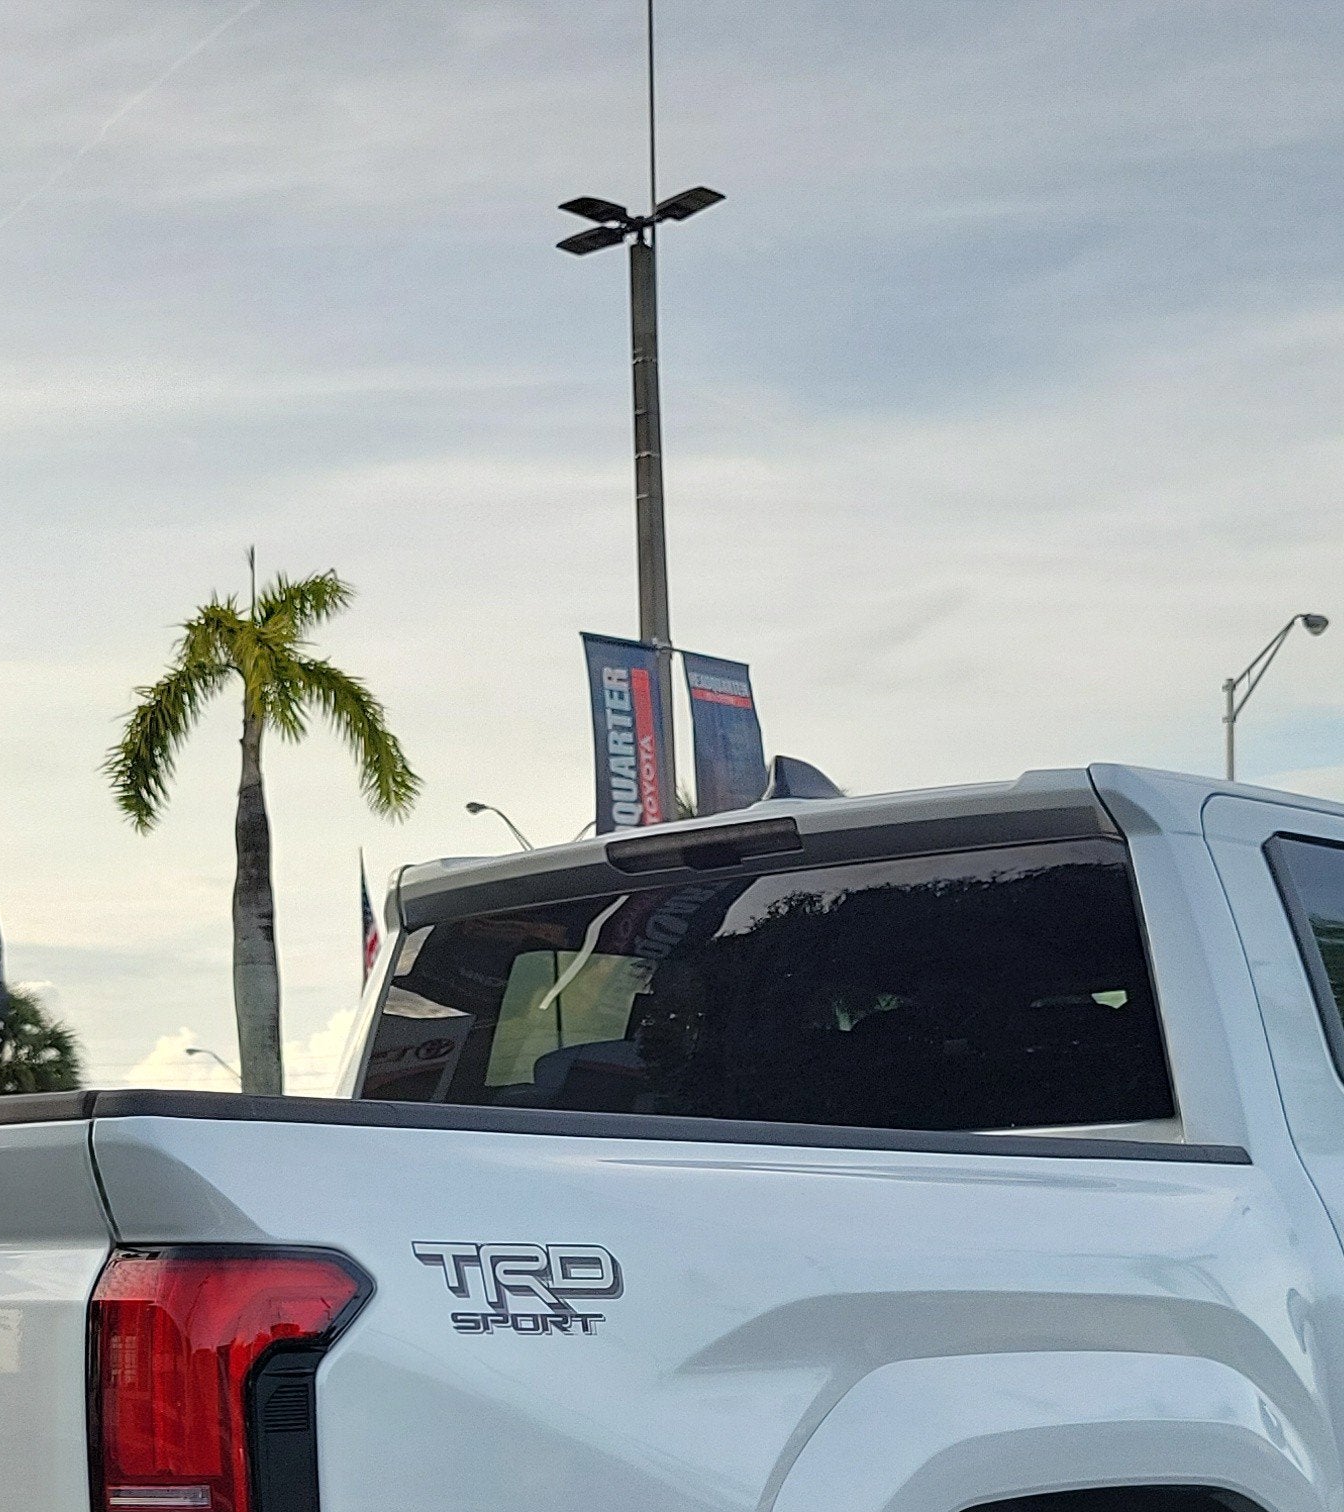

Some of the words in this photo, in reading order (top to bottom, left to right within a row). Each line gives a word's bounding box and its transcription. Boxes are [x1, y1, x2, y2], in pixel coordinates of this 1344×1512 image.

[602, 666, 644, 831] QUARTER
[411, 1240, 625, 1315] TRD
[450, 1312, 606, 1336] SPORT
